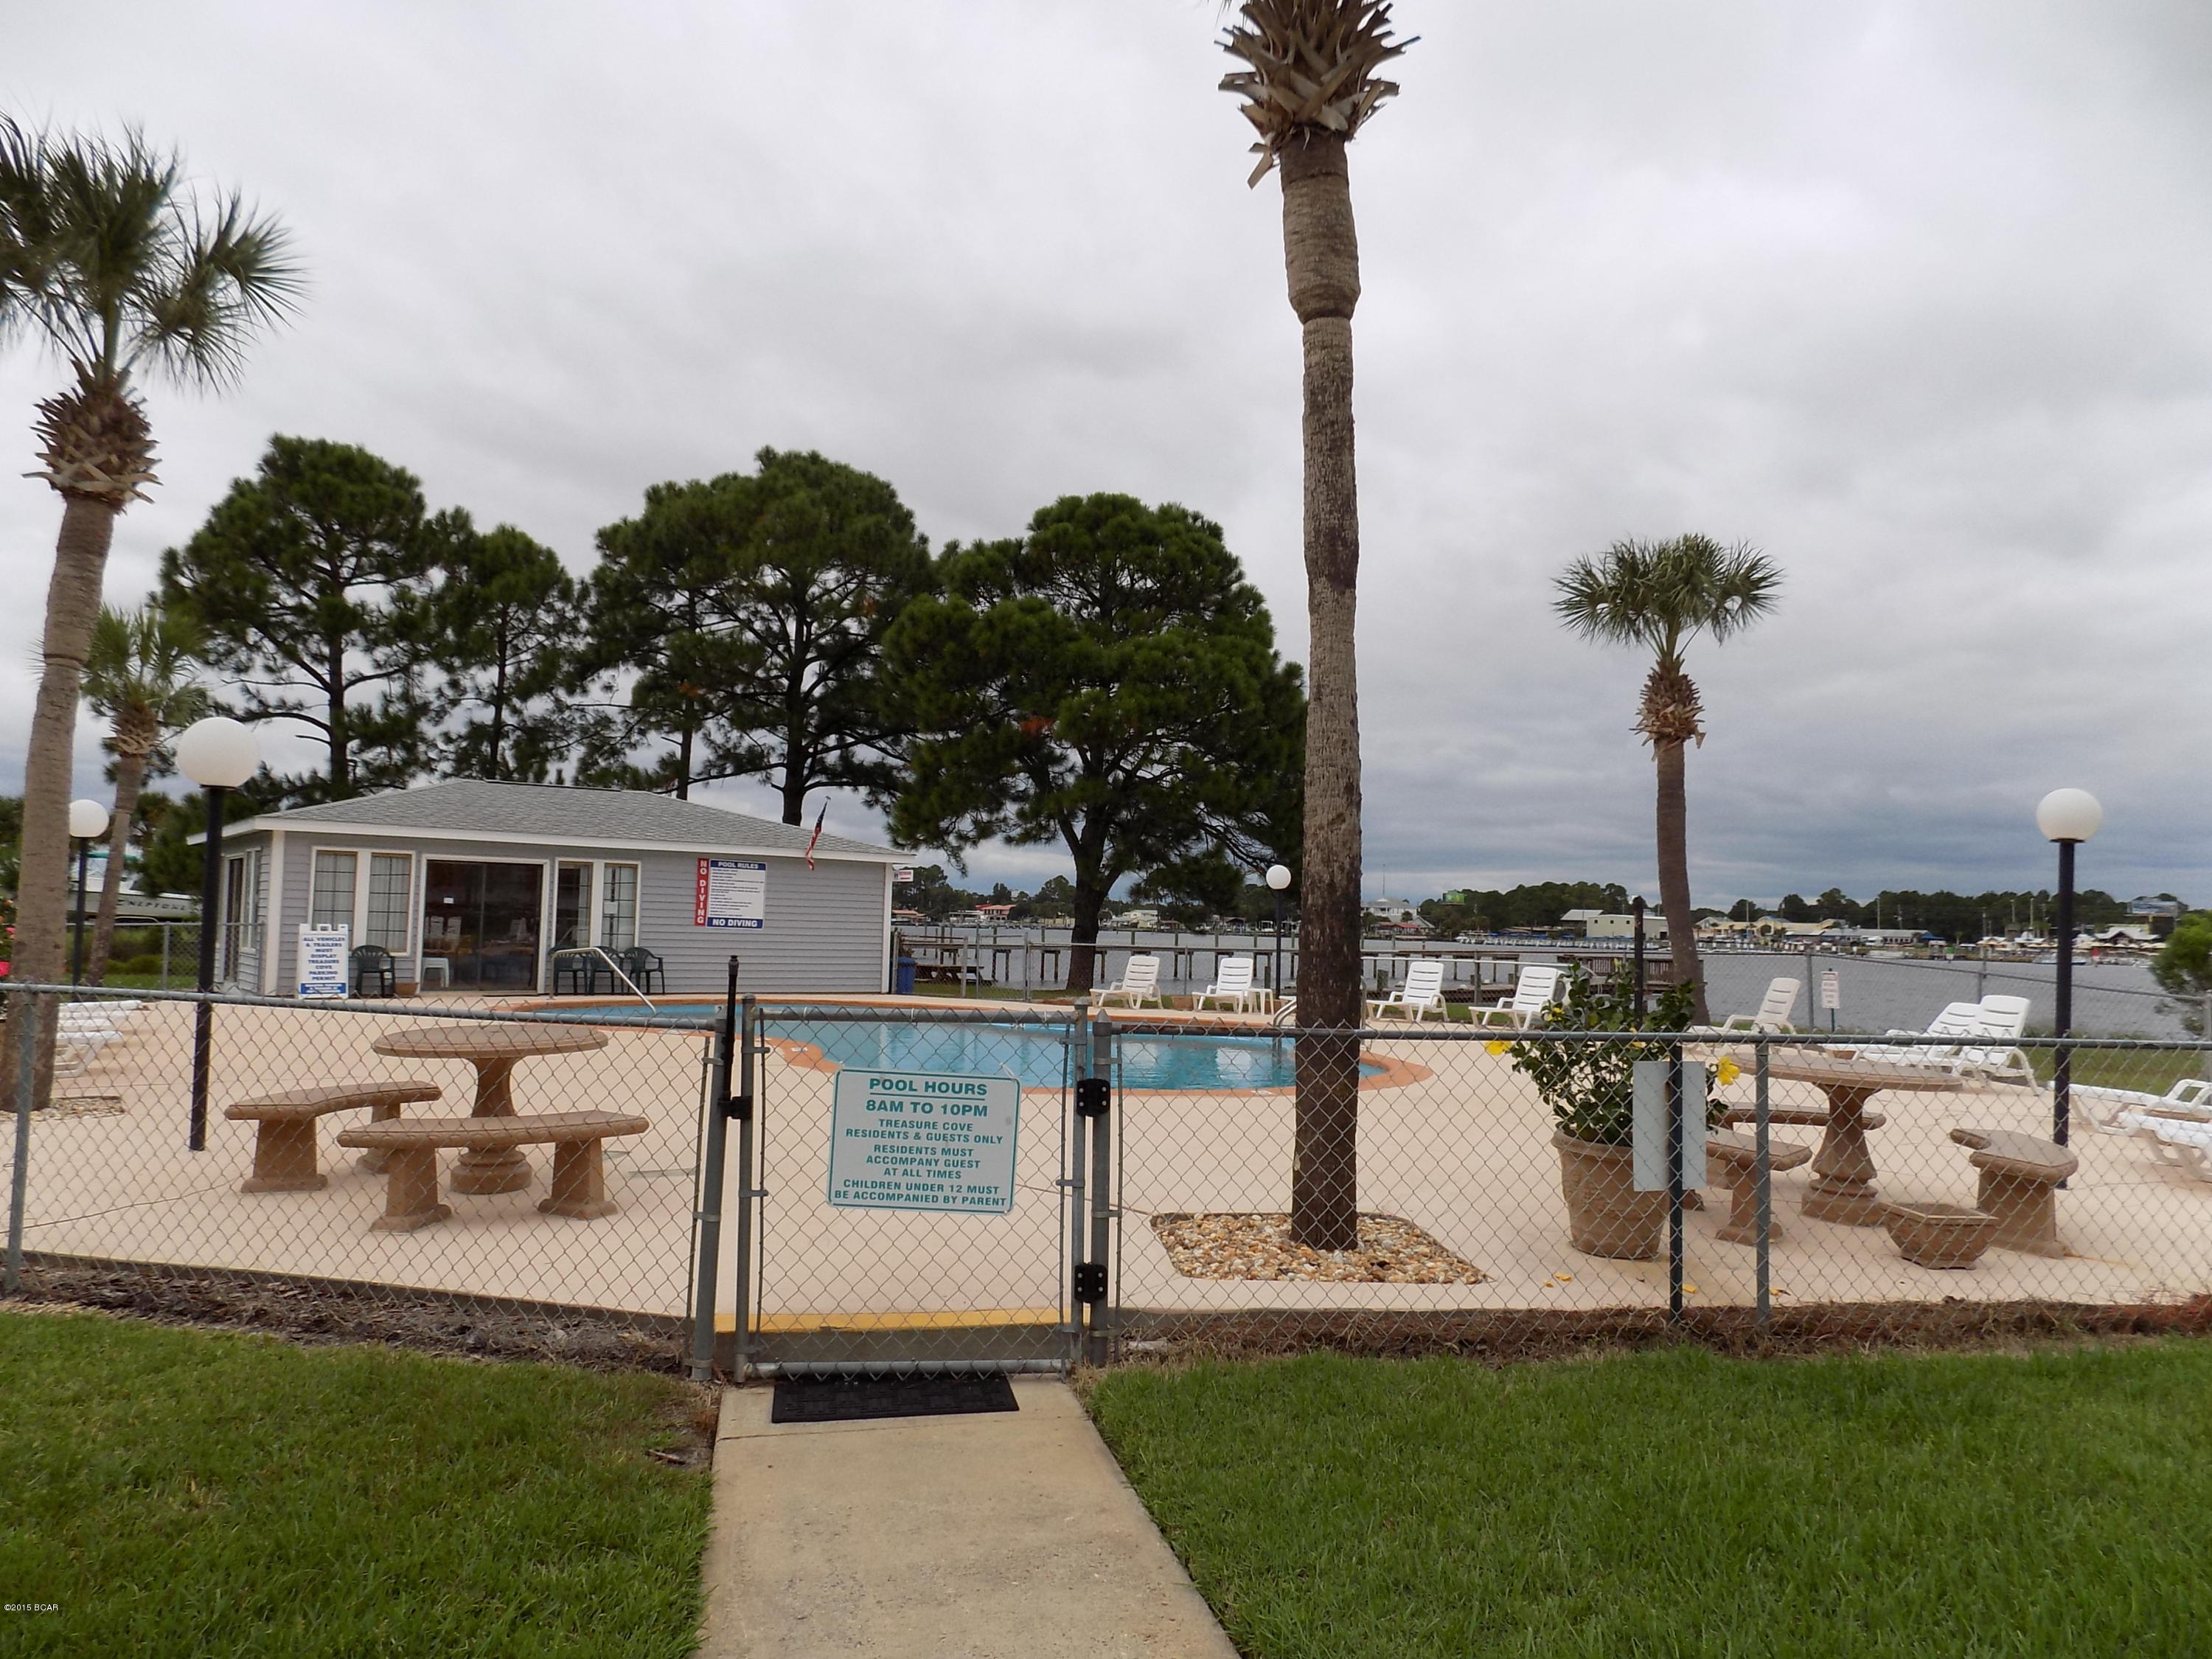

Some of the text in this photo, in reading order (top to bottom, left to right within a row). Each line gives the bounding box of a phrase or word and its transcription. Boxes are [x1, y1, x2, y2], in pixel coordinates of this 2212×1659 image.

[698, 860, 706, 923] NO DIVING
[869, 1079, 987, 1095] POOL HOURS
[866, 1100, 987, 1116] 8AM TO 10PM
[879, 1119, 973, 1131] TREASURE COVE
[846, 1129, 909, 1140] RESIDENTS
[926, 1133, 970, 1142] GUESTS
[974, 1135, 1003, 1144] ONLY
[874, 1145, 974, 1156] RESIDENTS MUST
[866, 1156, 981, 1169] ACCOMPANY GUEST
[884, 1168, 961, 1179] AT ALL TIMES
[844, 1180, 901, 1190] CHILDREN
[905, 1183, 944, 1192] UNDER
[967, 1186, 999, 1194] MUST
[835, 1191, 1006, 1206] BE ACCOMPANIED BY PARENT
